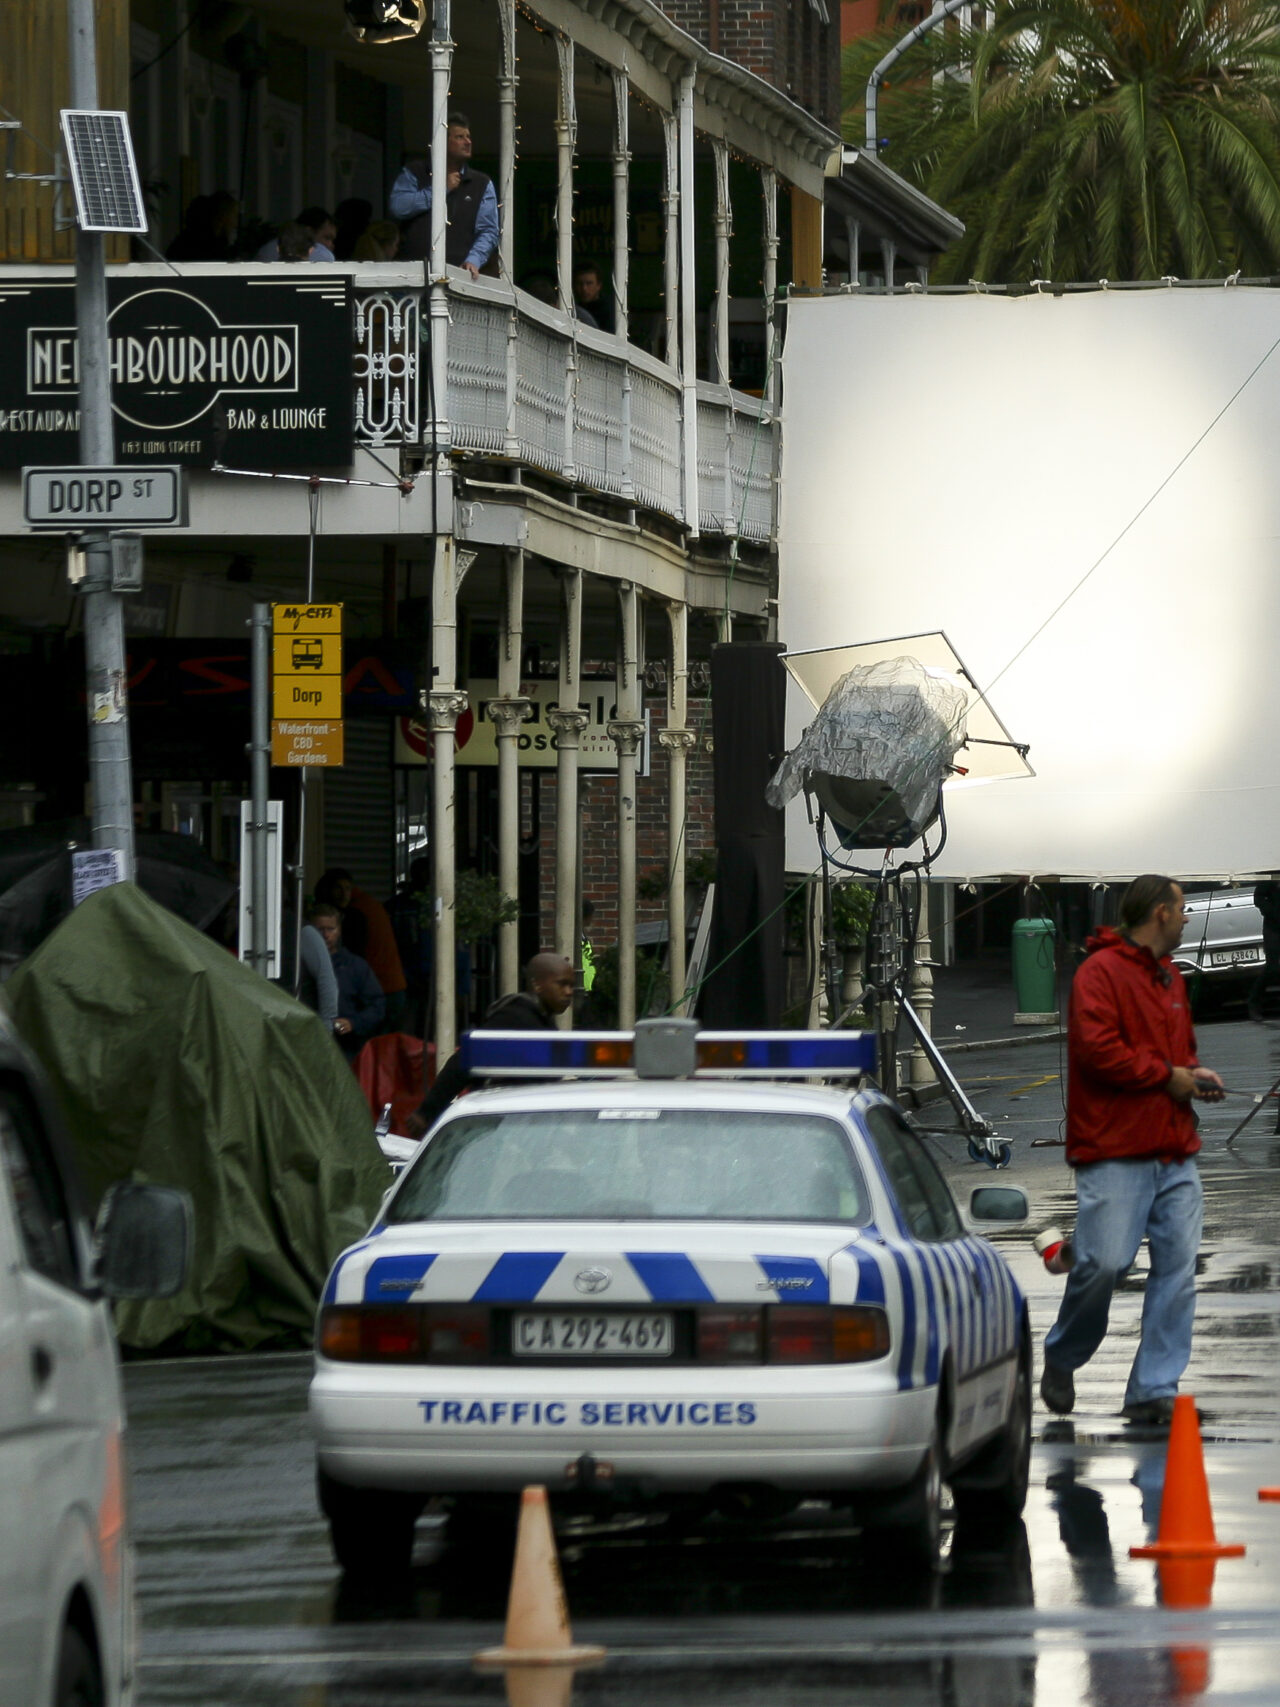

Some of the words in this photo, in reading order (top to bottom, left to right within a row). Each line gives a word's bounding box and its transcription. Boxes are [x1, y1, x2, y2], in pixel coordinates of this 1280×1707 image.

[34, 335, 292, 385] NEIHBOURHOOD
[226, 408, 256, 430] BAR
[260, 415, 269, 429] &
[273, 407, 327, 429] LOUNGE
[142, 440, 167, 454] LONG
[168, 440, 201, 454] STREET
[48, 480, 122, 514] DORP
[132, 478, 154, 499] ST
[292, 687, 322, 706] Dorp
[278, 723, 328, 735] Waterfront
[293, 737, 313, 749] CBD
[287, 751, 328, 764] Gardens
[418, 1400, 566, 1426] TRAFFIC
[579, 1400, 757, 1426] SERVICES
